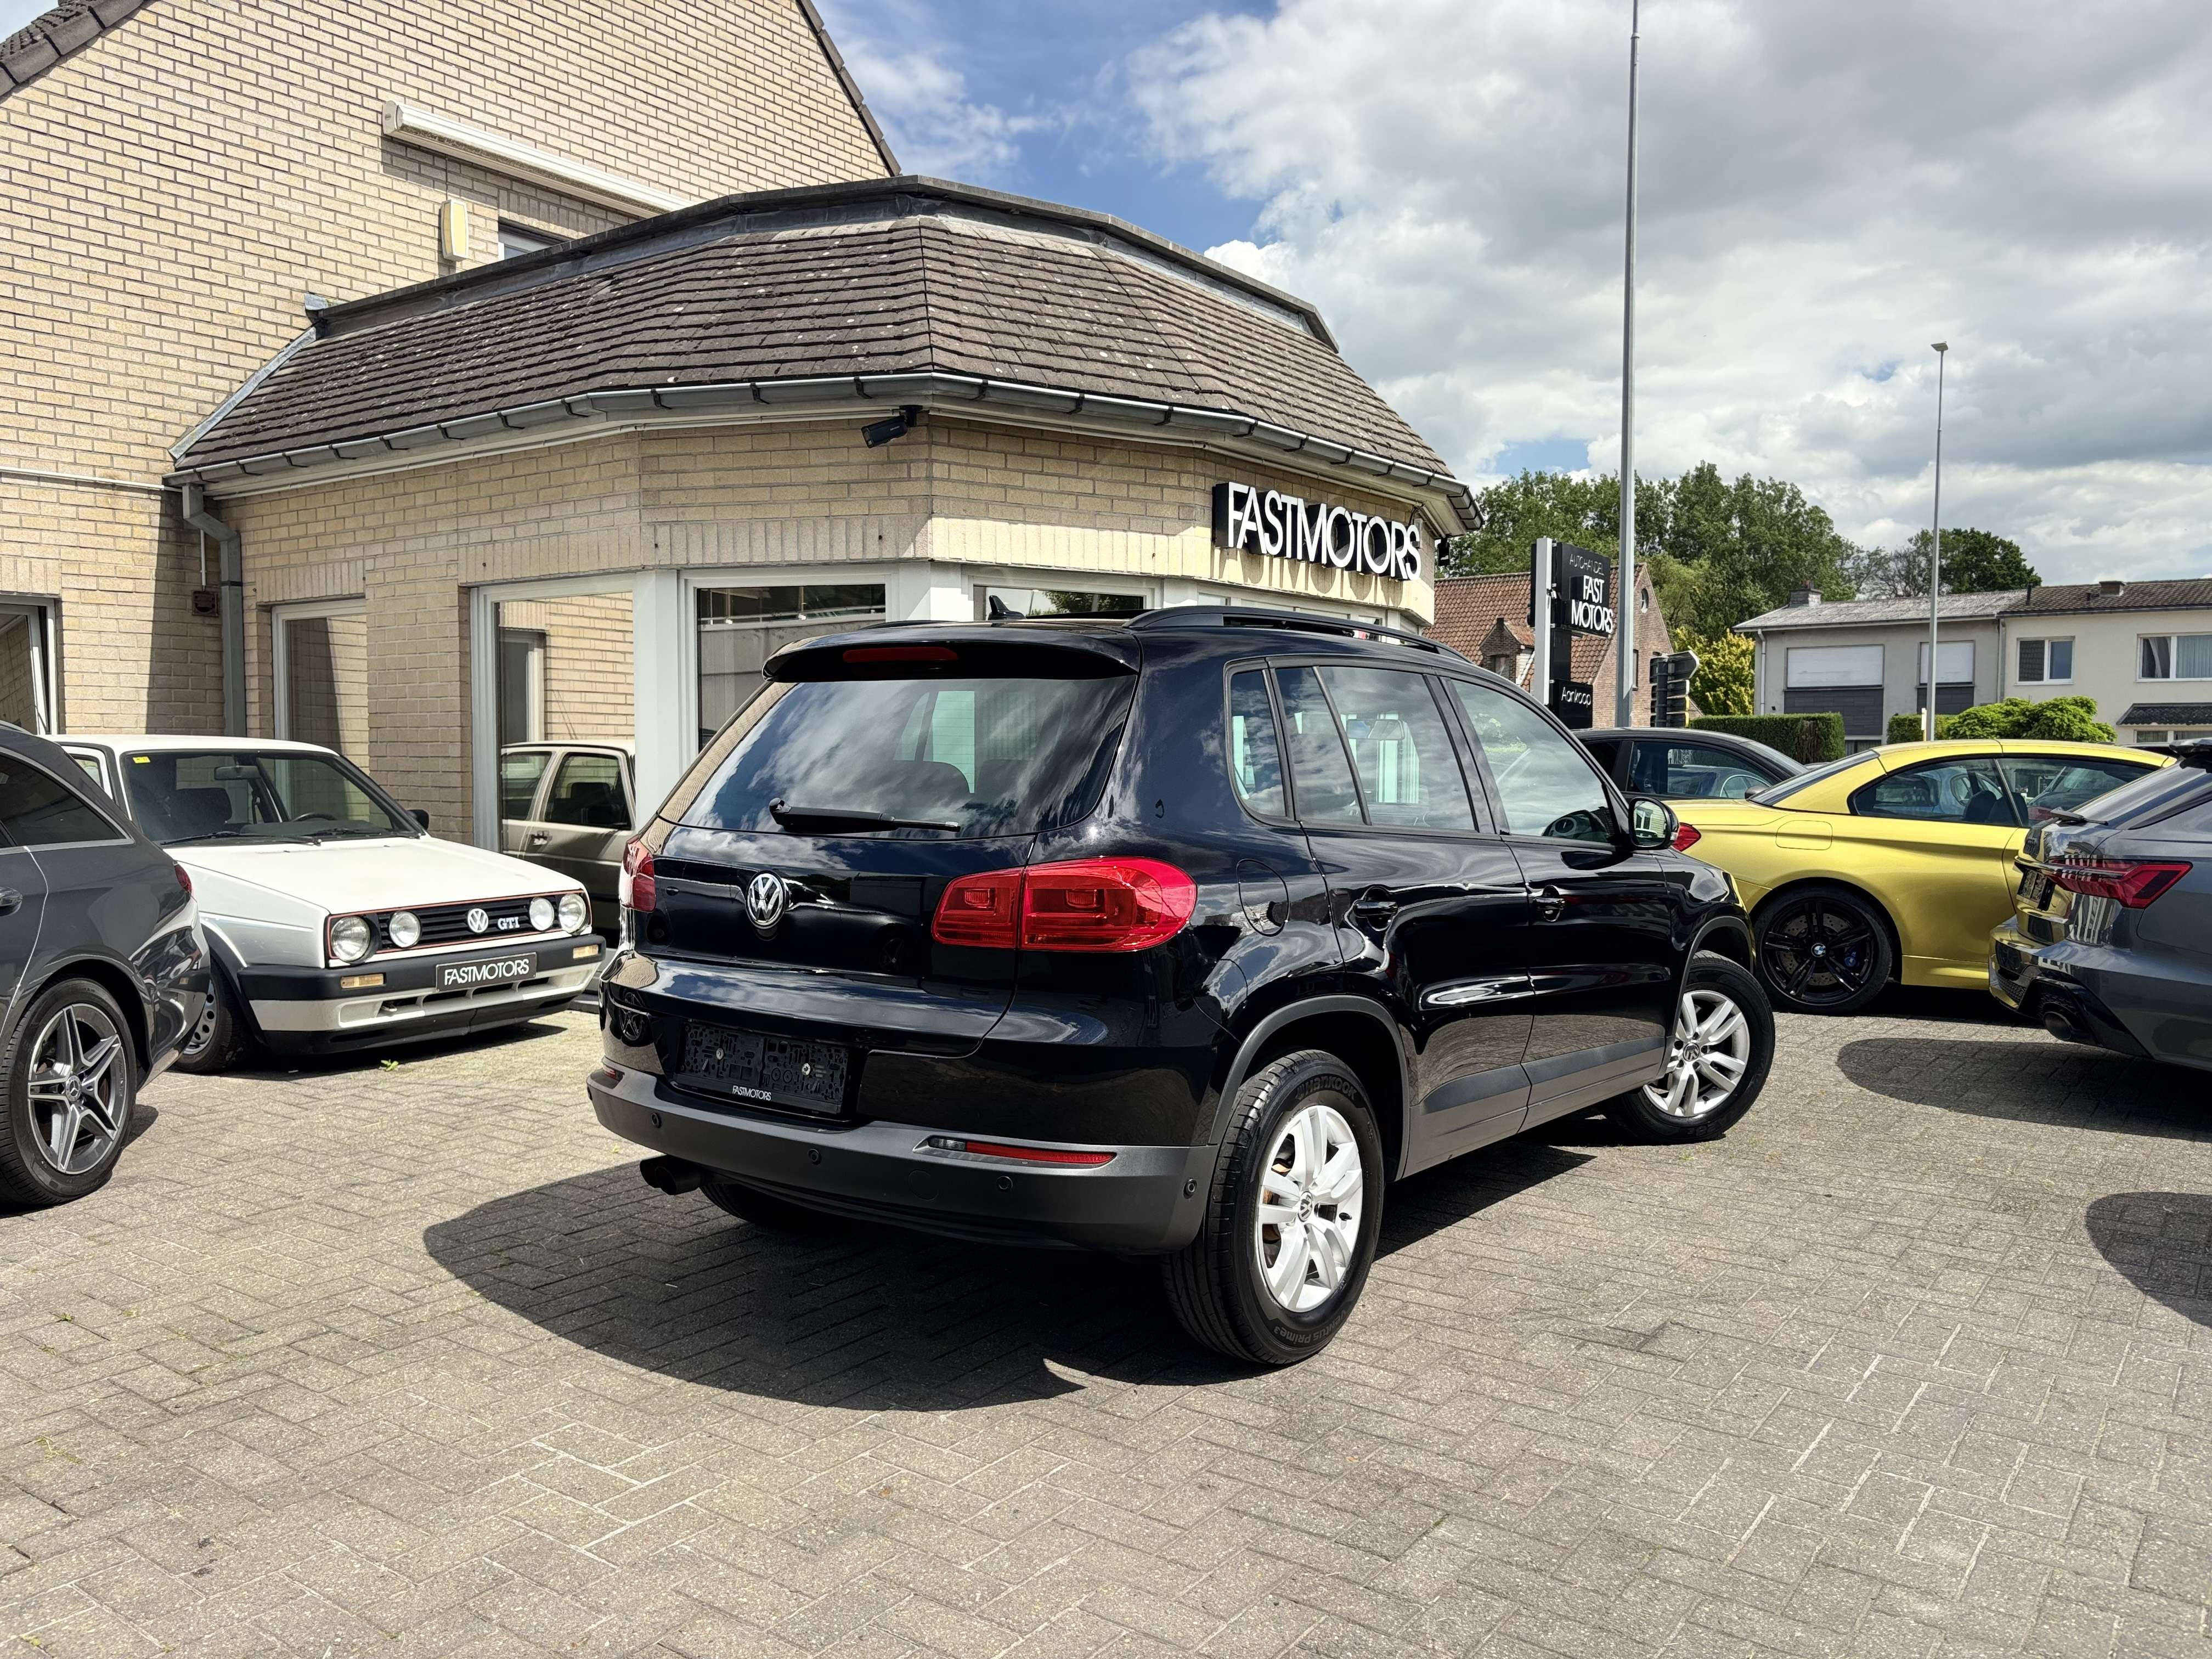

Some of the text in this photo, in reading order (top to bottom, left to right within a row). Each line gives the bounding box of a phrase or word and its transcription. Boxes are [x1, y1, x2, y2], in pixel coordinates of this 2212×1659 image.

[1228, 481, 1421, 580] FASTMOTORS
[1569, 554, 1605, 576] AUTOHANDEL
[1583, 574, 1605, 603] FAST
[1571, 599, 1613, 634] MOTORS
[1561, 686, 1591, 708] Aankoop
[498, 916, 520, 930] GTI
[444, 958, 529, 986] FASTMOTORS
[732, 1085, 772, 1101] FASTMOTORS
